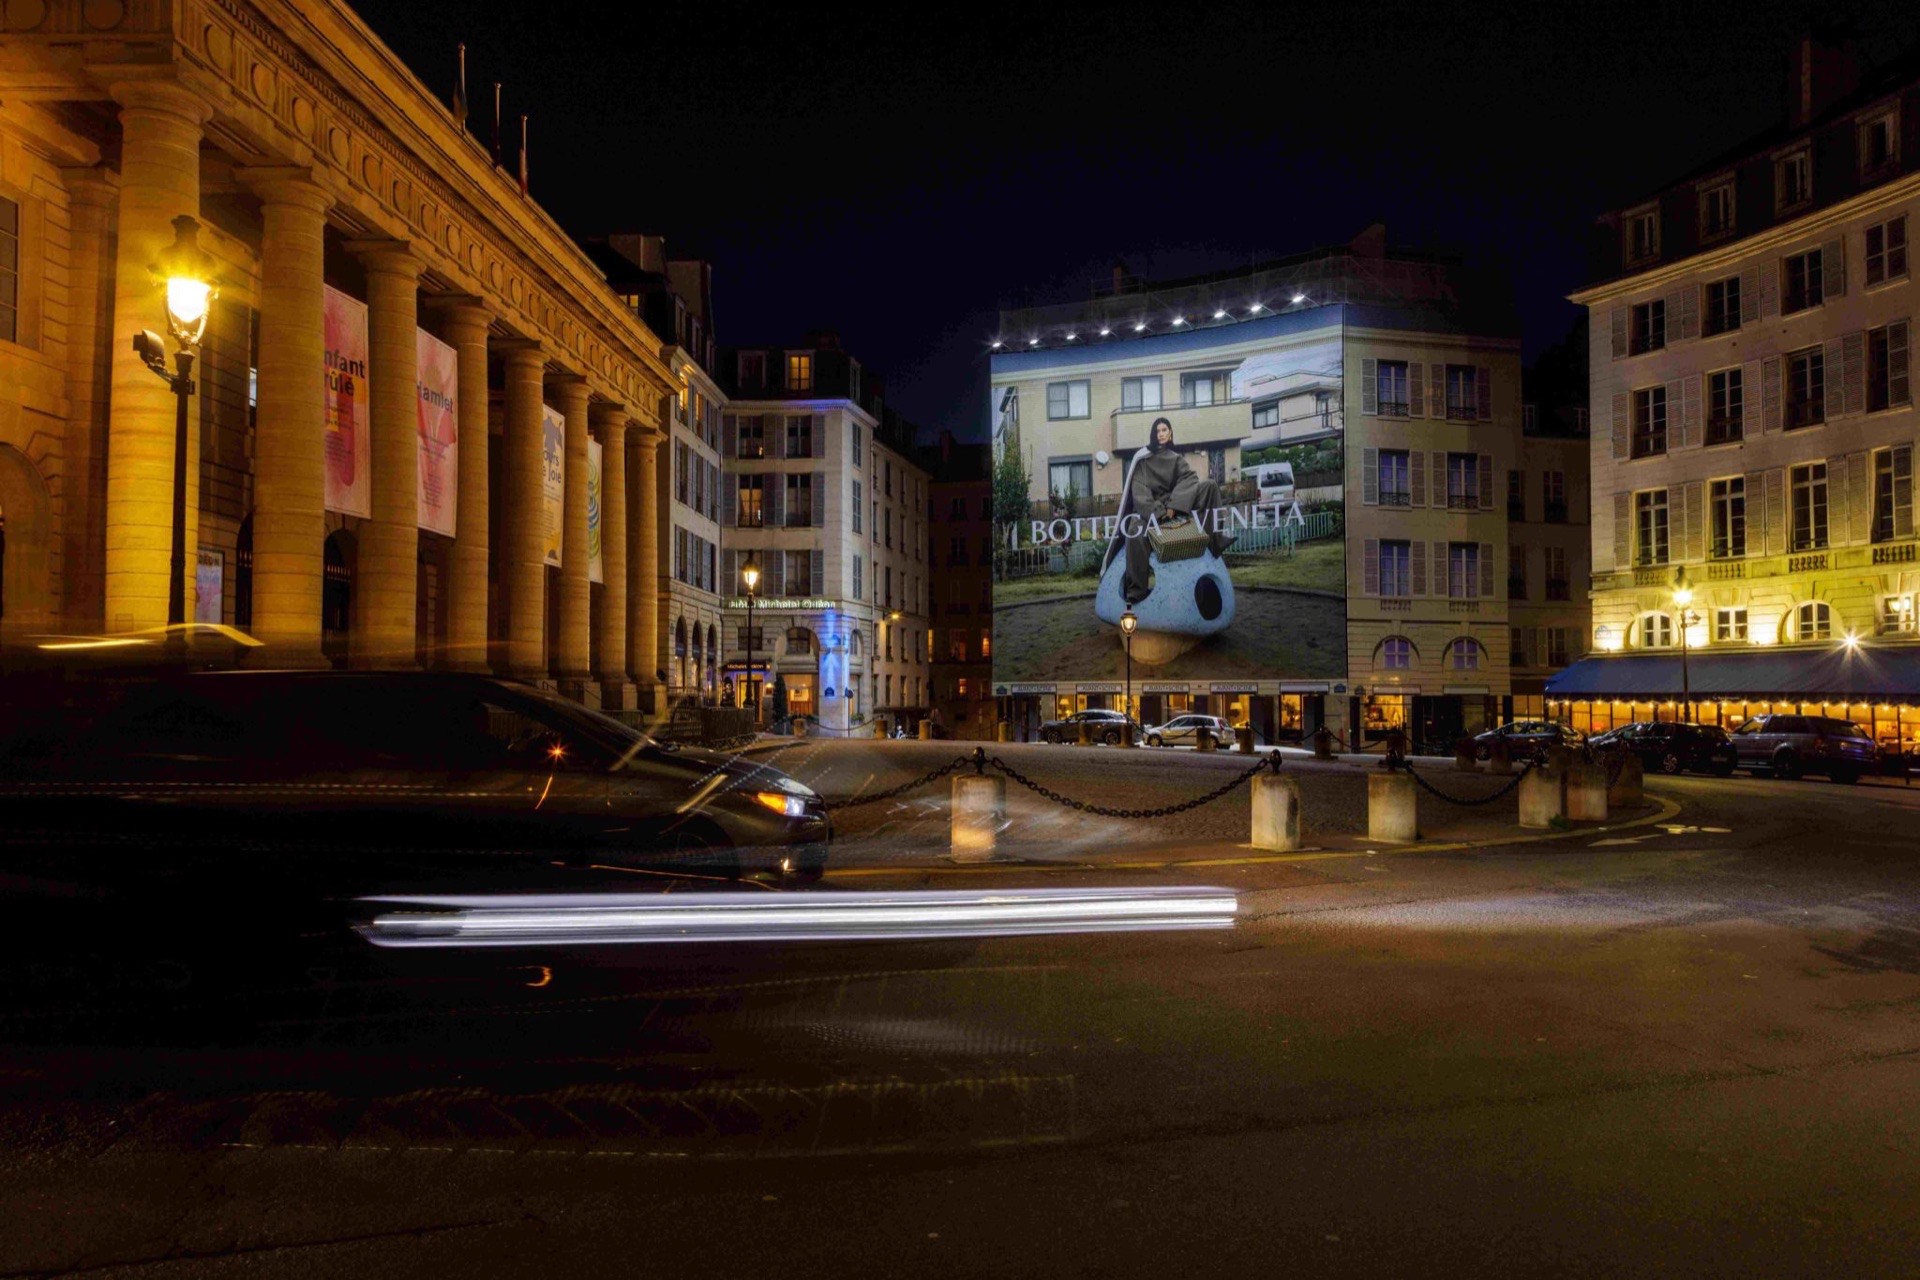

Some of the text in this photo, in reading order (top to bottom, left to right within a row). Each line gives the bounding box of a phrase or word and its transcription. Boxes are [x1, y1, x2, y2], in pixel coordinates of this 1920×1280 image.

[324, 348, 366, 379] nfant
[324, 369, 354, 396] rûlé
[1030, 500, 1306, 545] BOTTEGA VENETA
